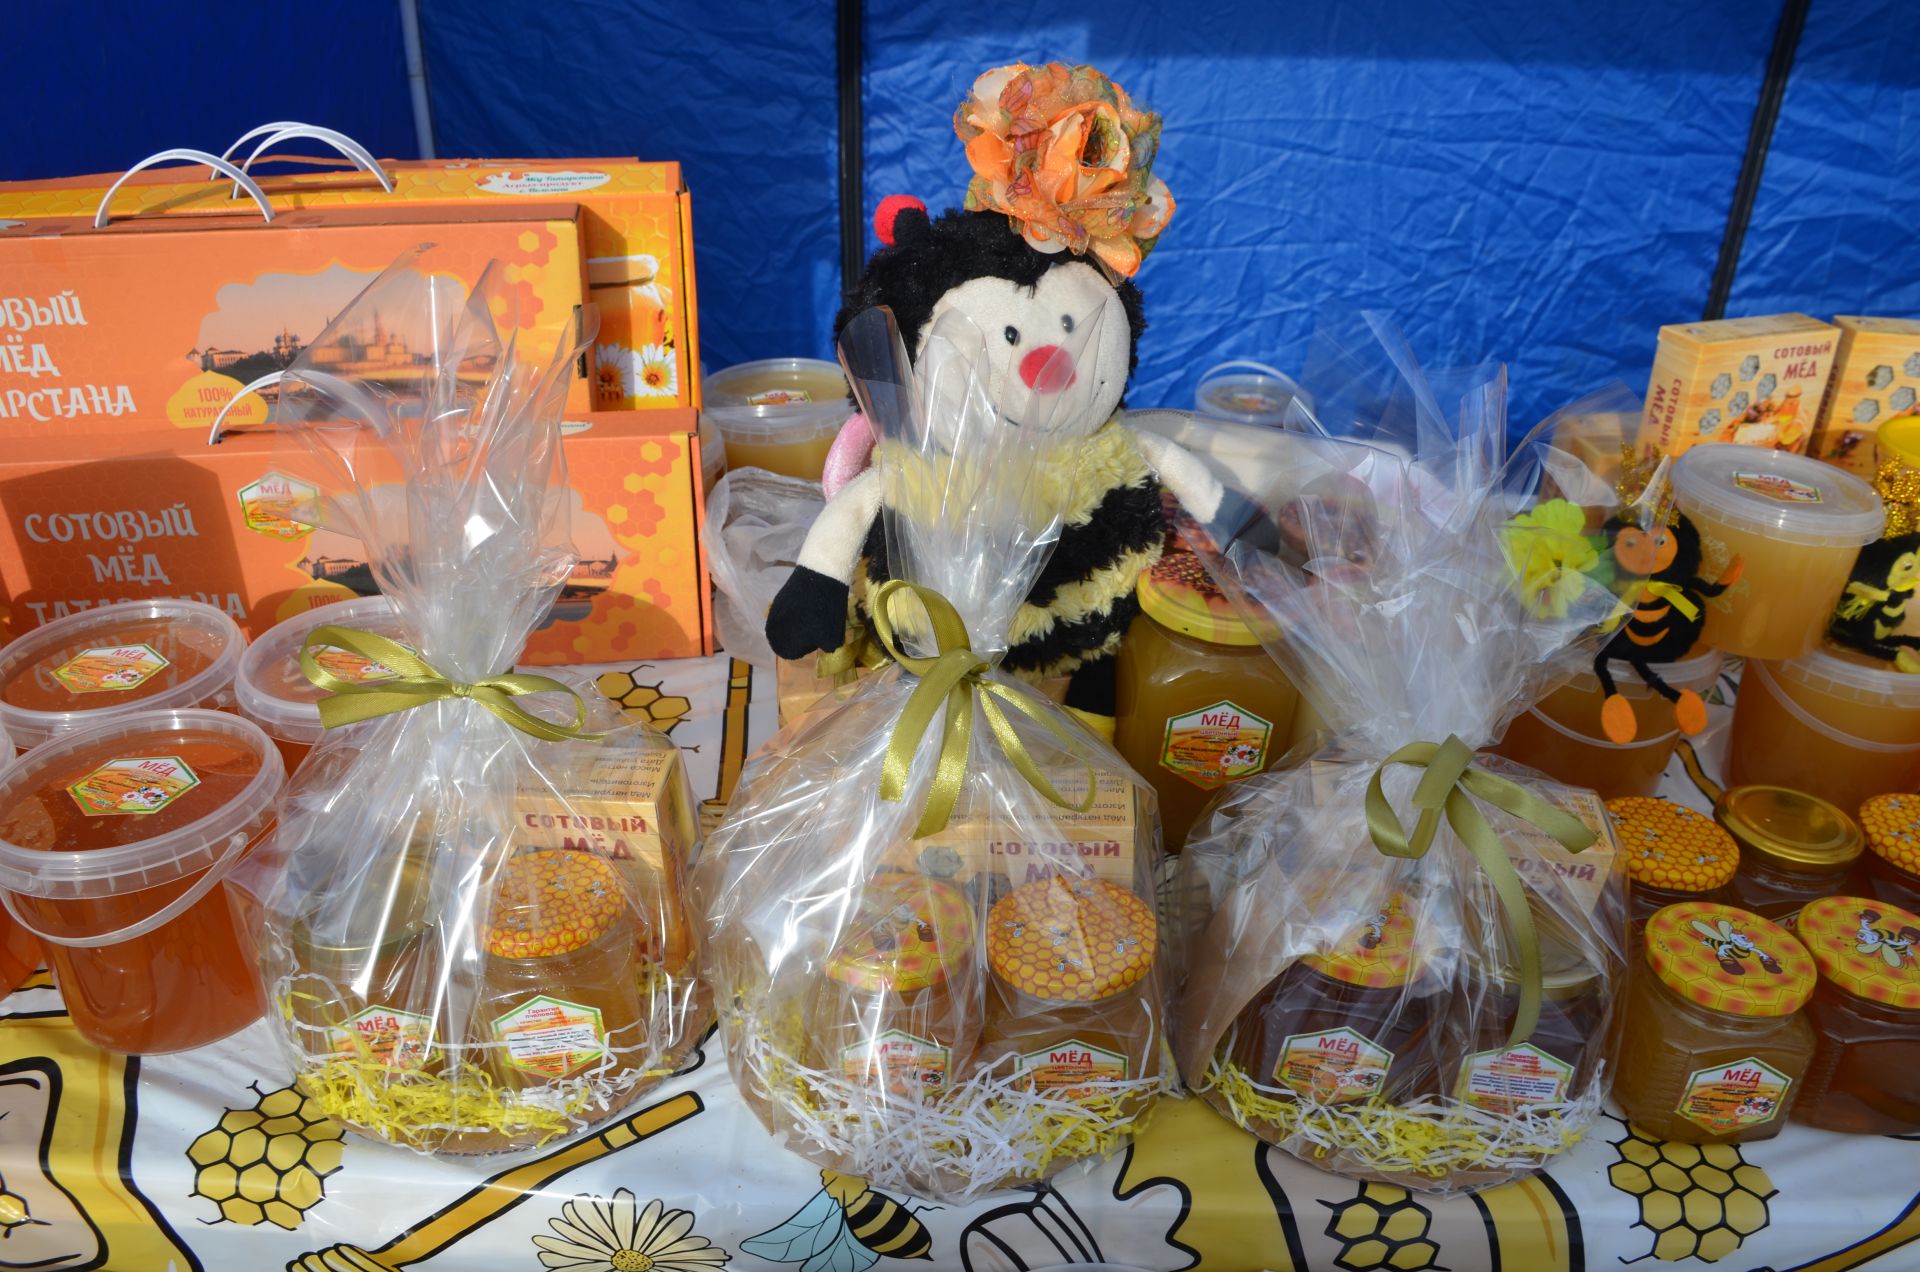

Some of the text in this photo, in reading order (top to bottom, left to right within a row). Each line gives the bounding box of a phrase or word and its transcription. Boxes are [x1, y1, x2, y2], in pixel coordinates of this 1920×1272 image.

[0, 290, 88, 331] ВЫЙ
[0, 335, 61, 378] ЁД
[1774, 341, 1832, 360] СОТОВЫЙ
[1783, 361, 1817, 381] МЁД
[0, 384, 137, 421] РСТАНА
[198, 387, 233, 402] 100%
[1660, 378, 1682, 447] СОТОВЫЙ
[25, 503, 199, 543] СОТОВЫЙ
[87, 545, 172, 586] МЁД
[111, 649, 148, 660] МЁД
[1201, 712, 1240, 729] МЁД
[138, 760, 178, 777] МЁД
[525, 813, 647, 833] СОТОВЫЙ
[989, 840, 1120, 857] СОТОВЫЙ
[356, 1015, 400, 1032] МЁД
[1318, 1036, 1360, 1055] МЁД
[1050, 1049, 1093, 1066] МЁД
[1723, 1069, 1762, 1083] МЁД
